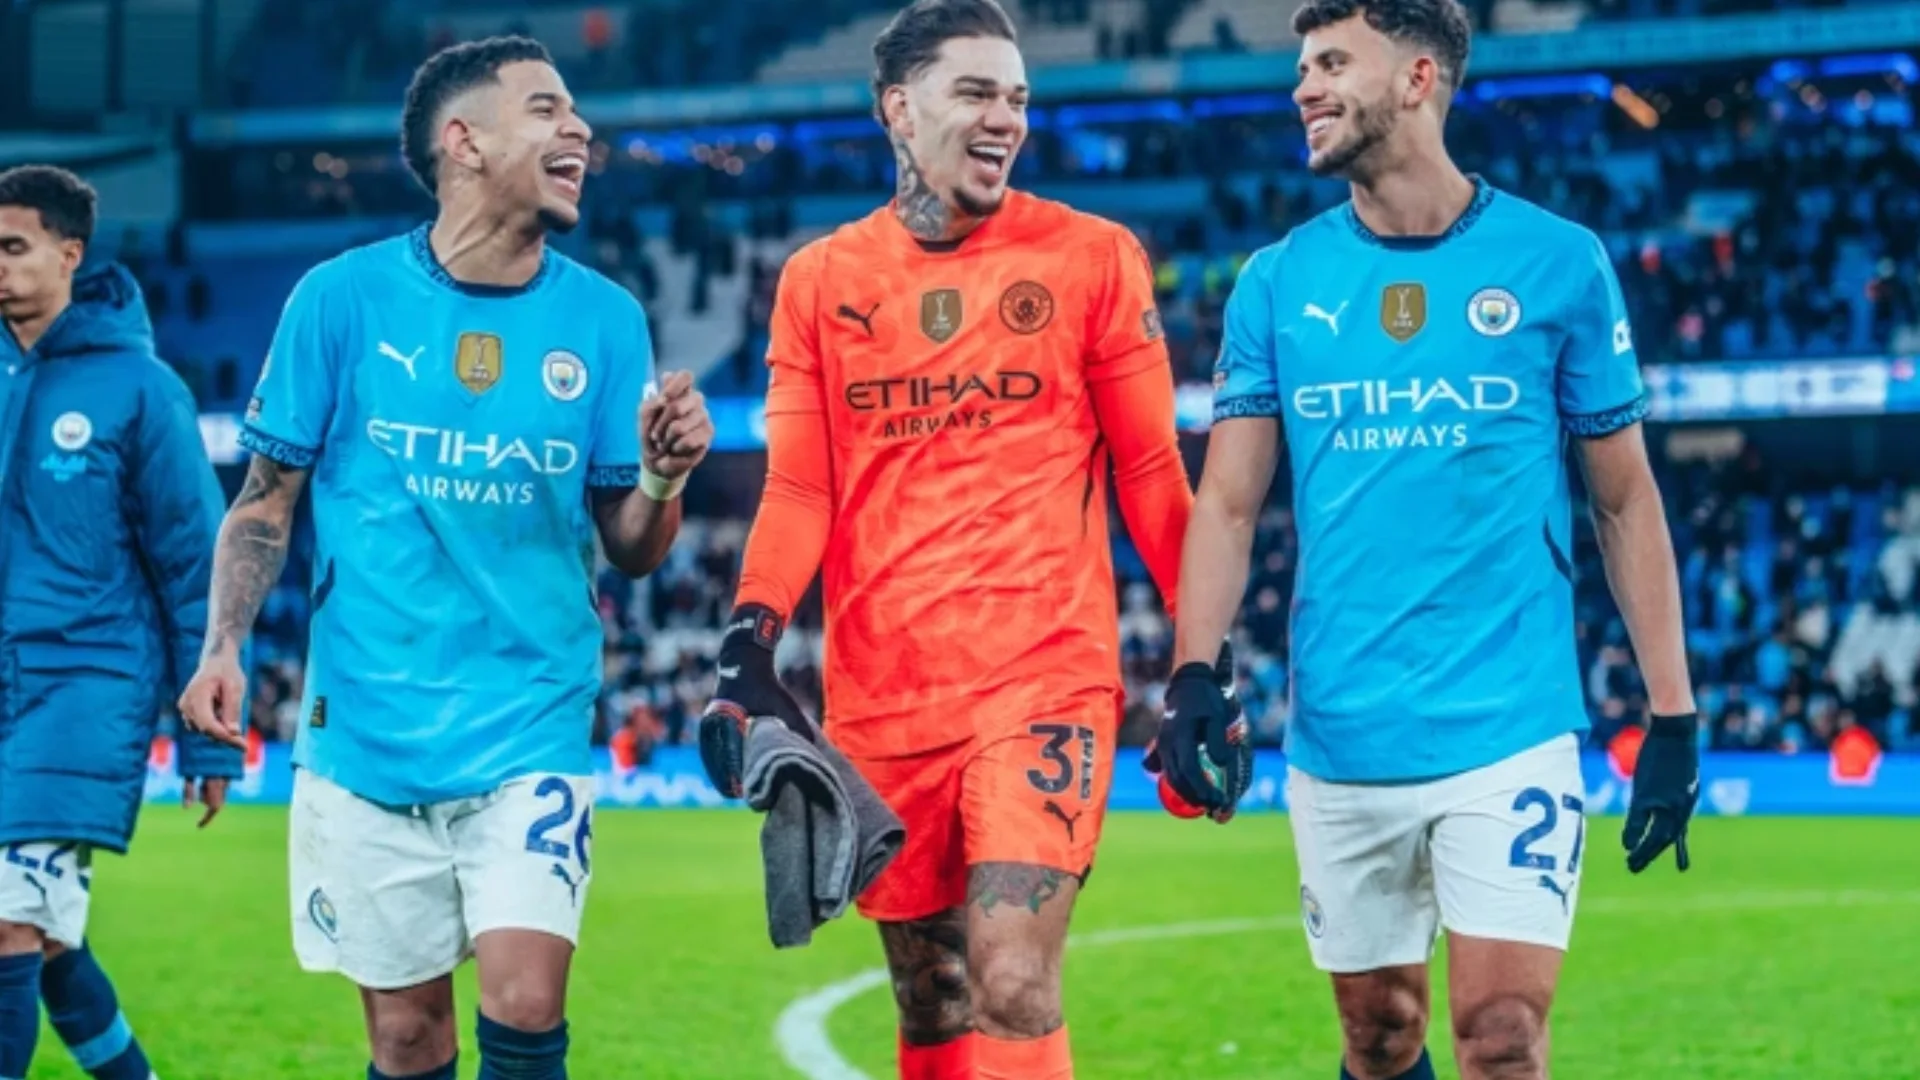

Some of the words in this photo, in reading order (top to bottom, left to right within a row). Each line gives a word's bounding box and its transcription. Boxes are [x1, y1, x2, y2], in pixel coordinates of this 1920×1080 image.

[846, 371, 1041, 409] ETIHAD
[1294, 375, 1519, 418] ETIHAD
[884, 410, 991, 437] AIRWAYS
[1333, 424, 1467, 450] AIRWAYS
[367, 419, 577, 473] ETIHAD
[406, 474, 534, 504] AIRWAYS
[1027, 725, 1093, 799] 31
